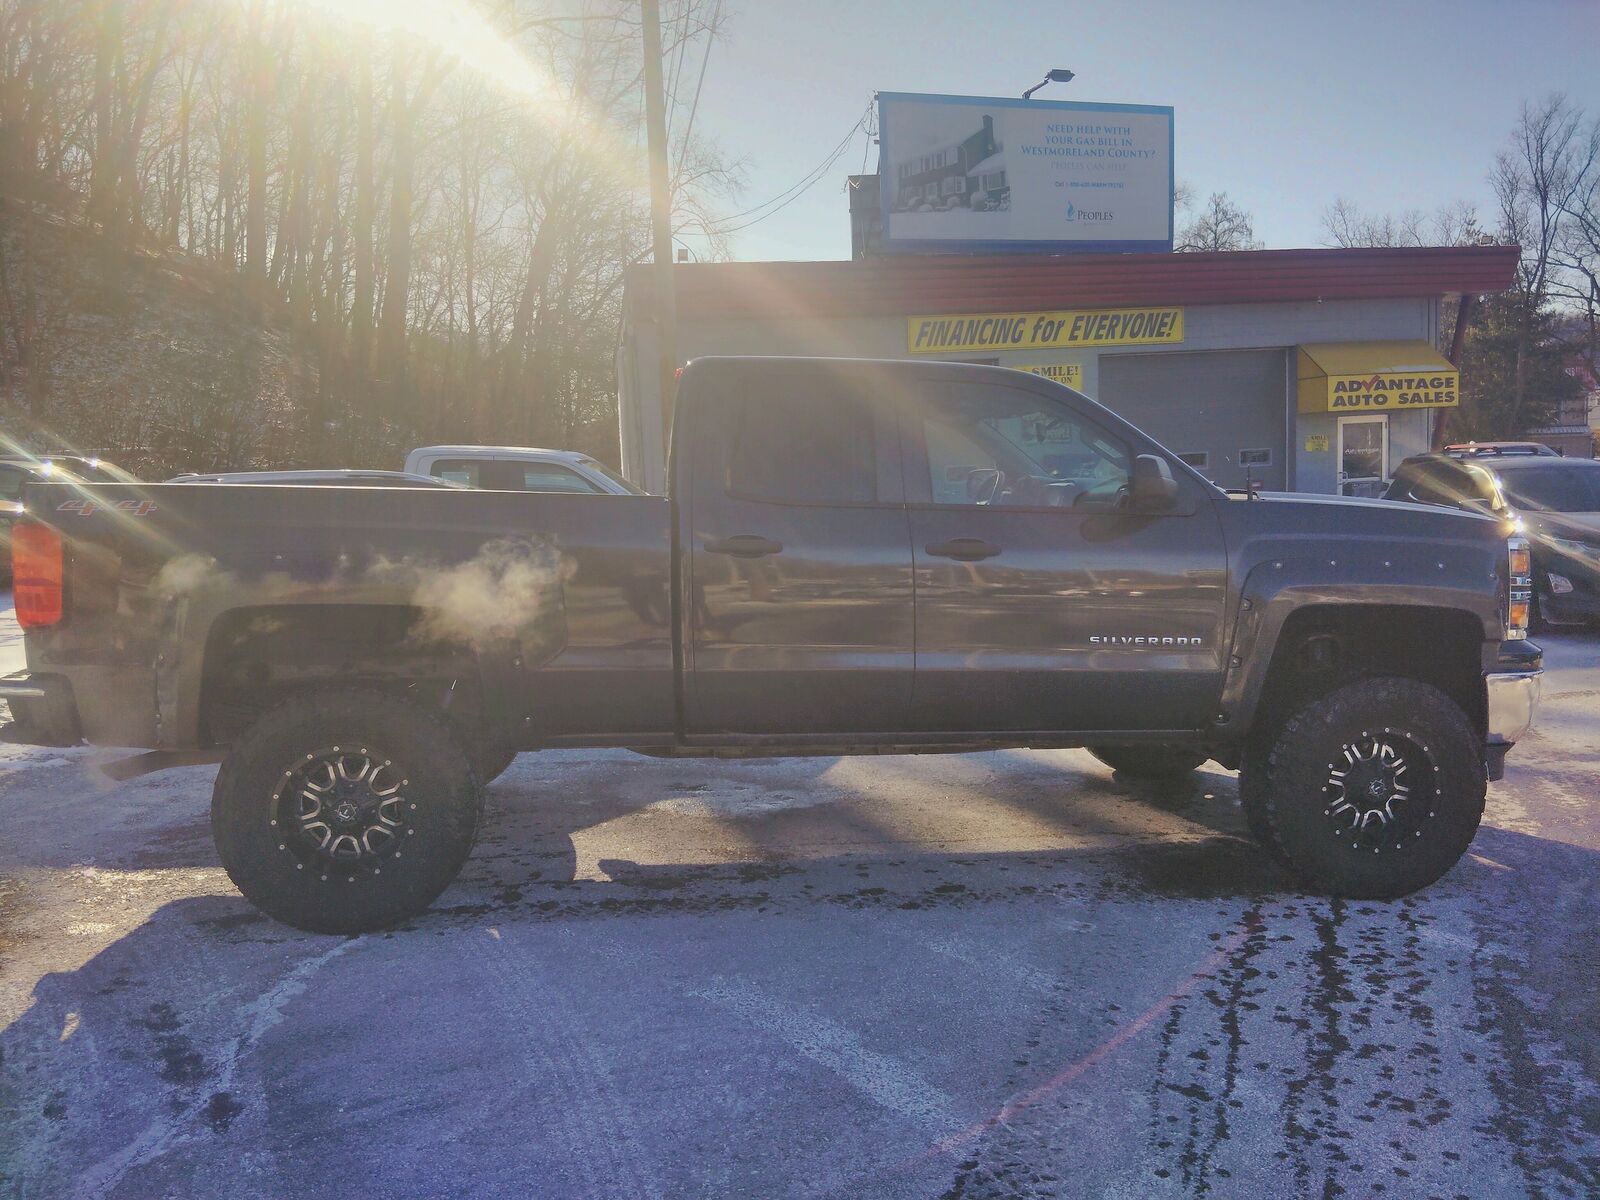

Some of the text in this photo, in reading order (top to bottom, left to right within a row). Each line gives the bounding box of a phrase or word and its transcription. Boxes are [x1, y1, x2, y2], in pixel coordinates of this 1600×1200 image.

[1047, 124, 1131, 136] NEED HELP WITH
[1045, 135, 1133, 147] YOUR GAS BILL IN
[1021, 145, 1105, 157] WESTMORELAND
[1077, 210, 1113, 221] PEOPLES
[915, 311, 1178, 348] FINANCING for EVERYONE!
[1333, 375, 1455, 393] ADVANTAGE
[1332, 391, 1455, 407] AUTO SALES
[1089, 636, 1202, 646] SILVERADO
